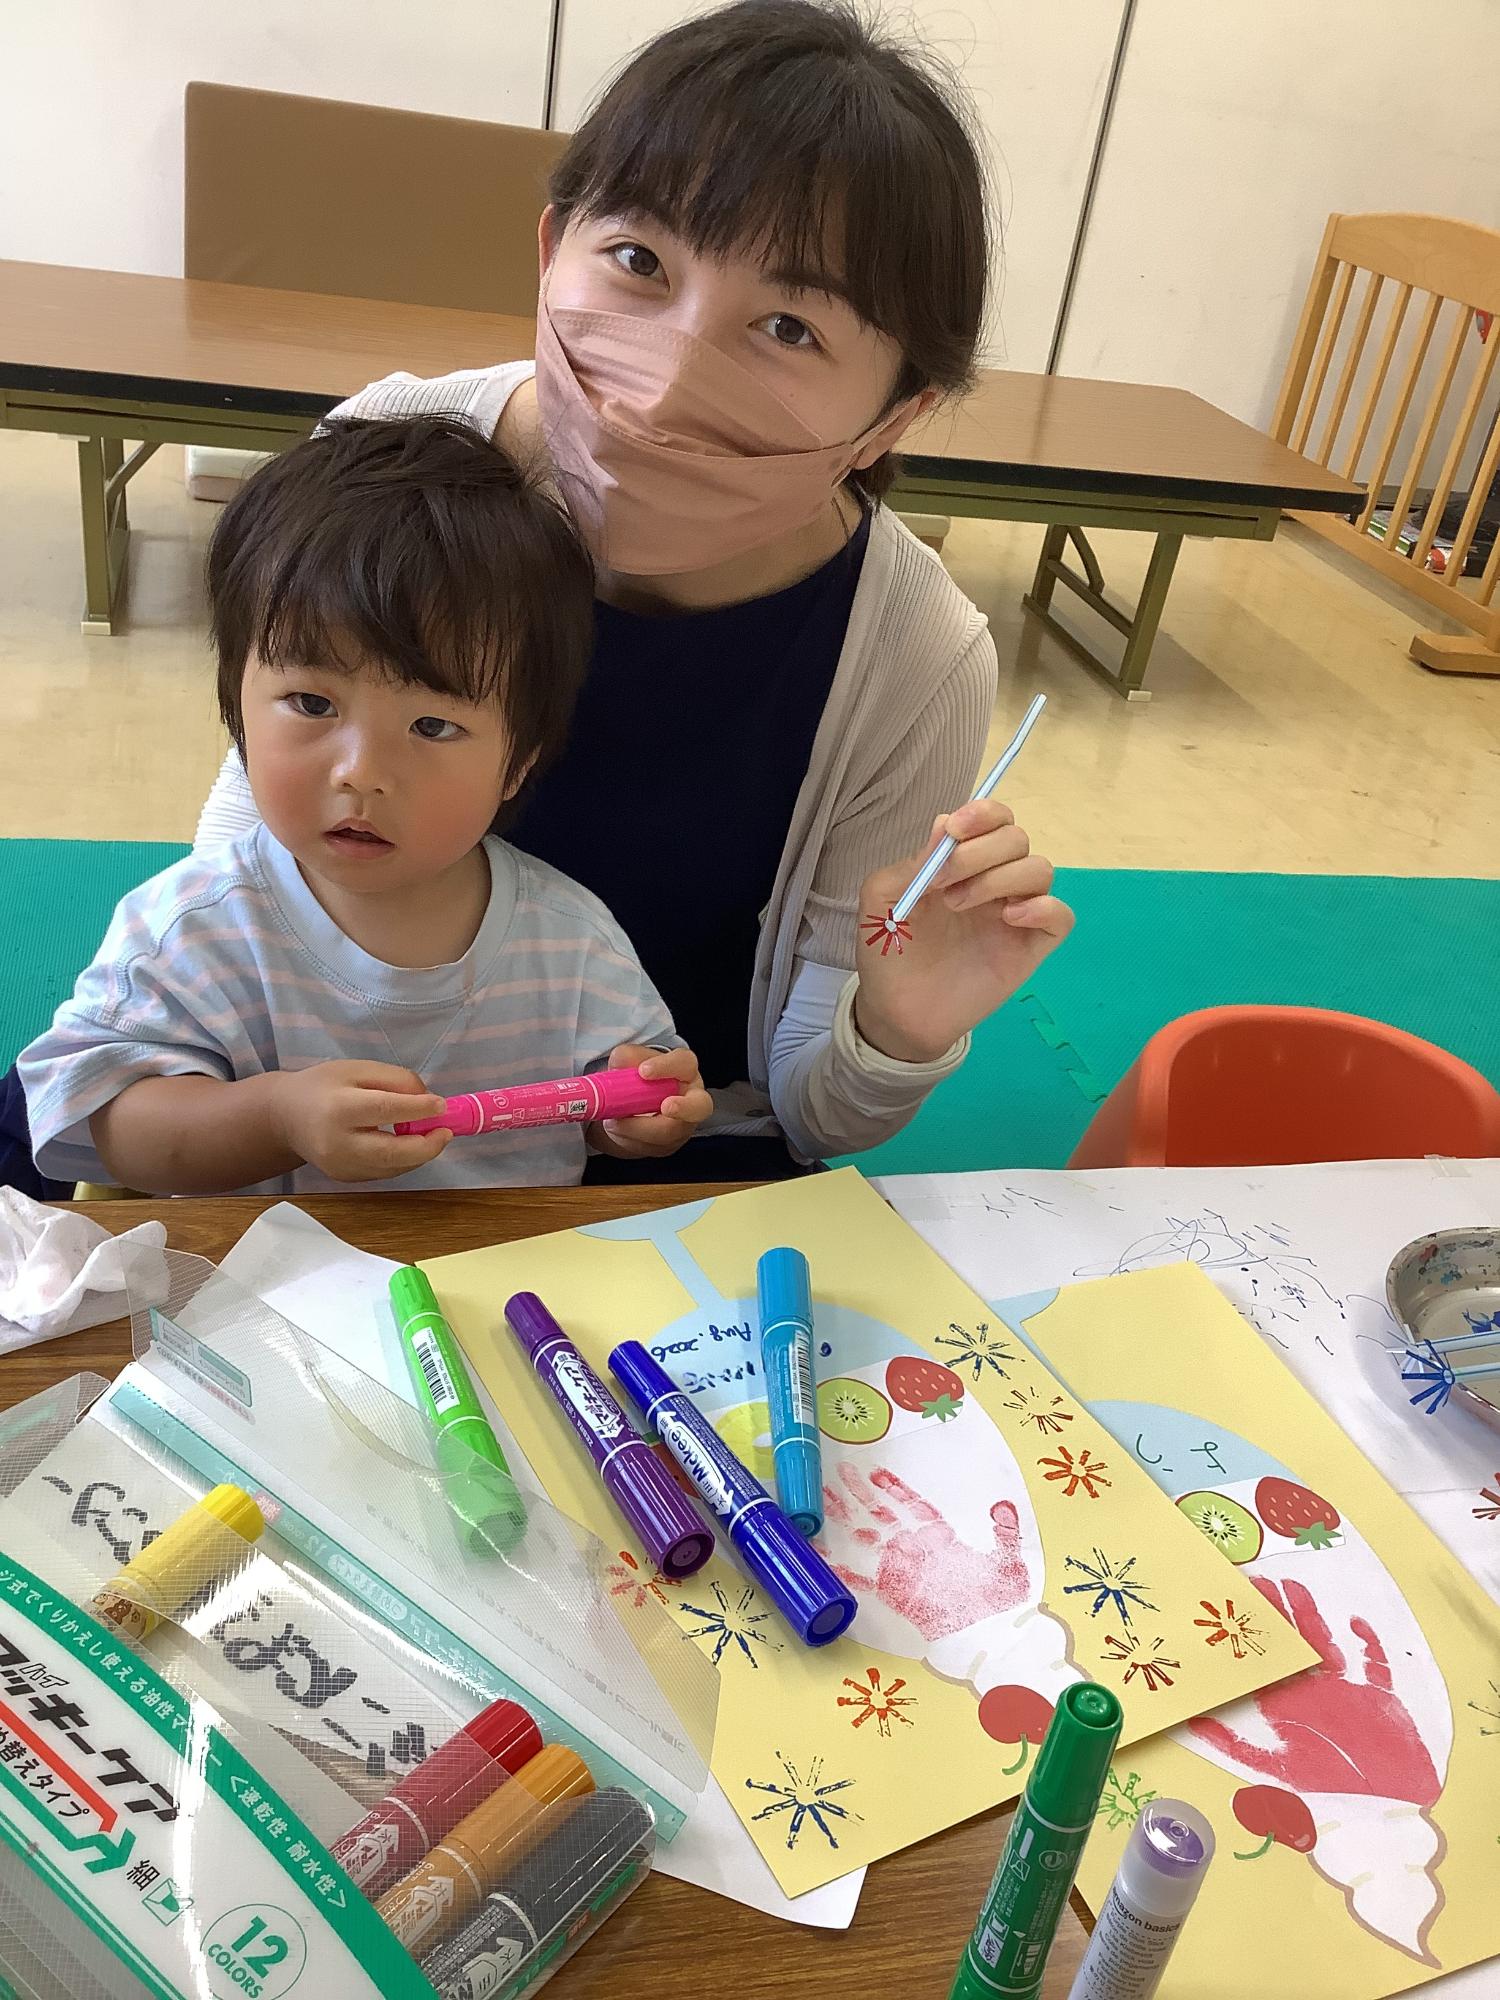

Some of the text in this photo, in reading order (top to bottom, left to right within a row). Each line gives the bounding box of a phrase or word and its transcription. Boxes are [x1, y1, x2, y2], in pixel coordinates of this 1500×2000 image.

[126, 1859, 161, 1892] 細
[208, 1943, 264, 1999] COLORS
[232, 1915, 288, 1979] 12
